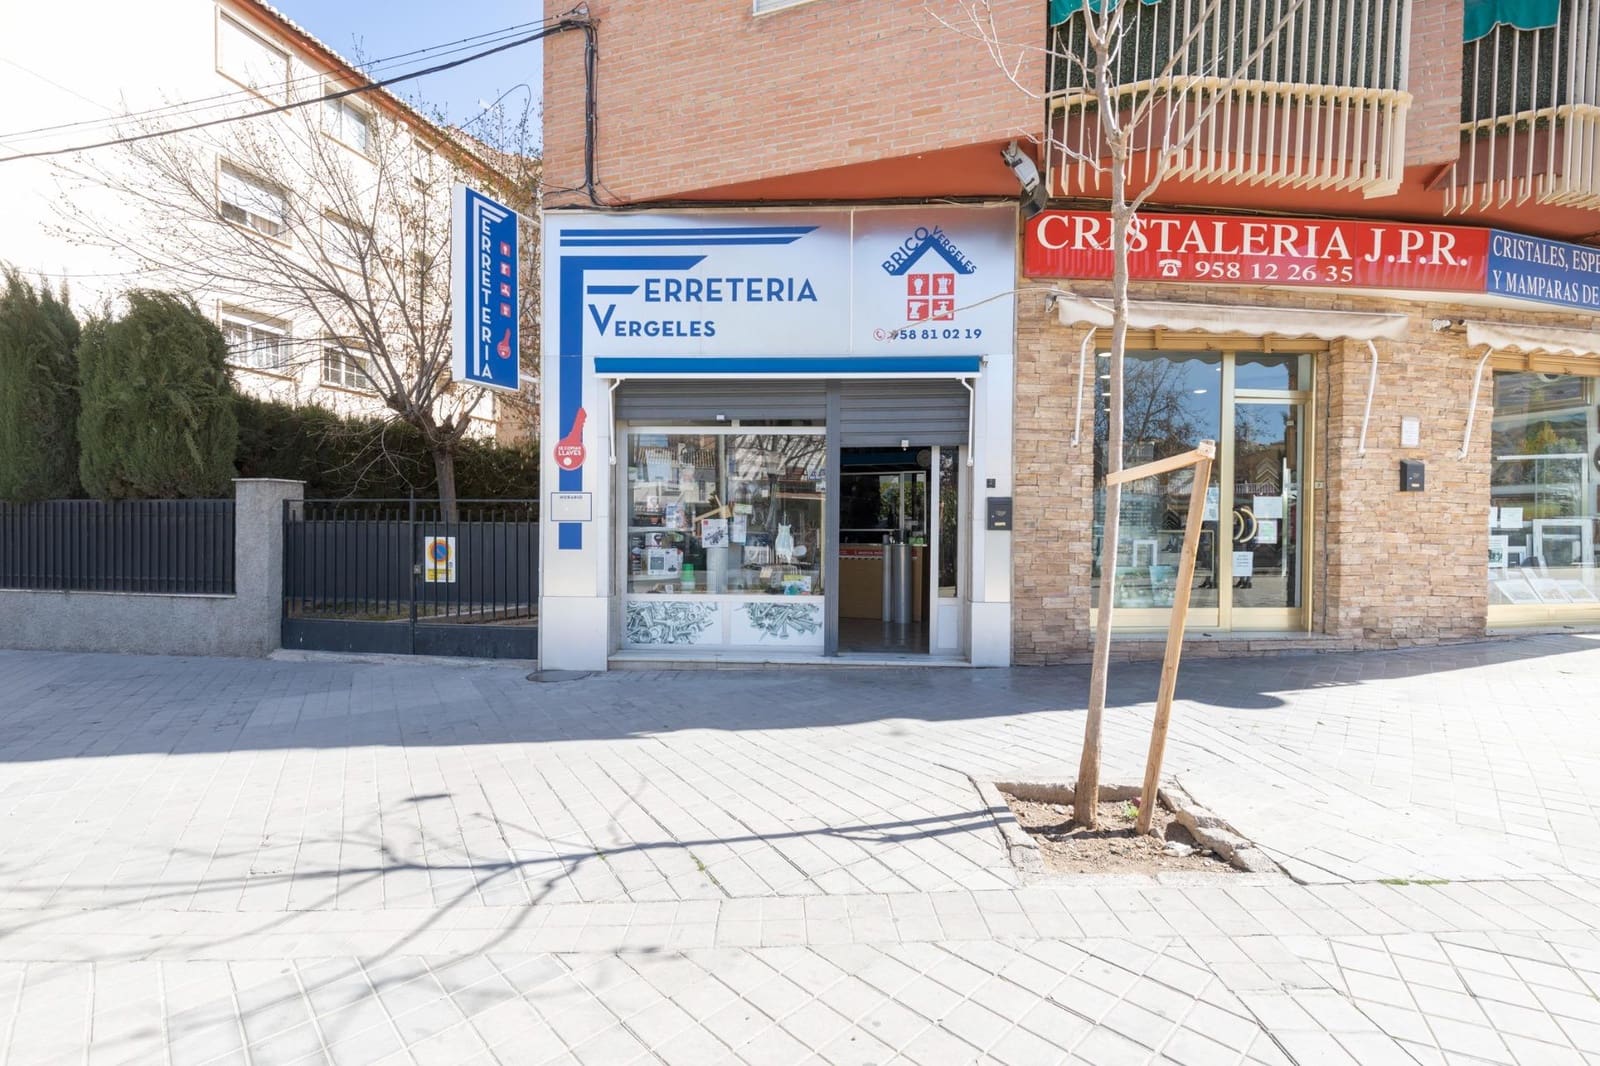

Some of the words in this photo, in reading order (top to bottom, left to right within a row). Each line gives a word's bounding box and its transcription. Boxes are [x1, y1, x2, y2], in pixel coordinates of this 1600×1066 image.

[882, 226, 929, 275] BRICO
[932, 225, 978, 273] VERGELES
[1364, 227, 1469, 267] J.P.R.
[1493, 235, 1569, 272] CRISTALES,
[1194, 261, 1241, 279] 958
[1251, 262, 1279, 280] 12
[1286, 264, 1318, 282] 26
[1325, 265, 1353, 283] 35
[1492, 269, 1502, 290] Y
[1506, 271, 1579, 303] MAMPARAS
[1582, 284, 1600, 306] DE
[588, 304, 716, 337] VERGELES
[921, 329, 938, 340] 81
[942, 328, 960, 340] 02
[965, 328, 982, 339] 19
